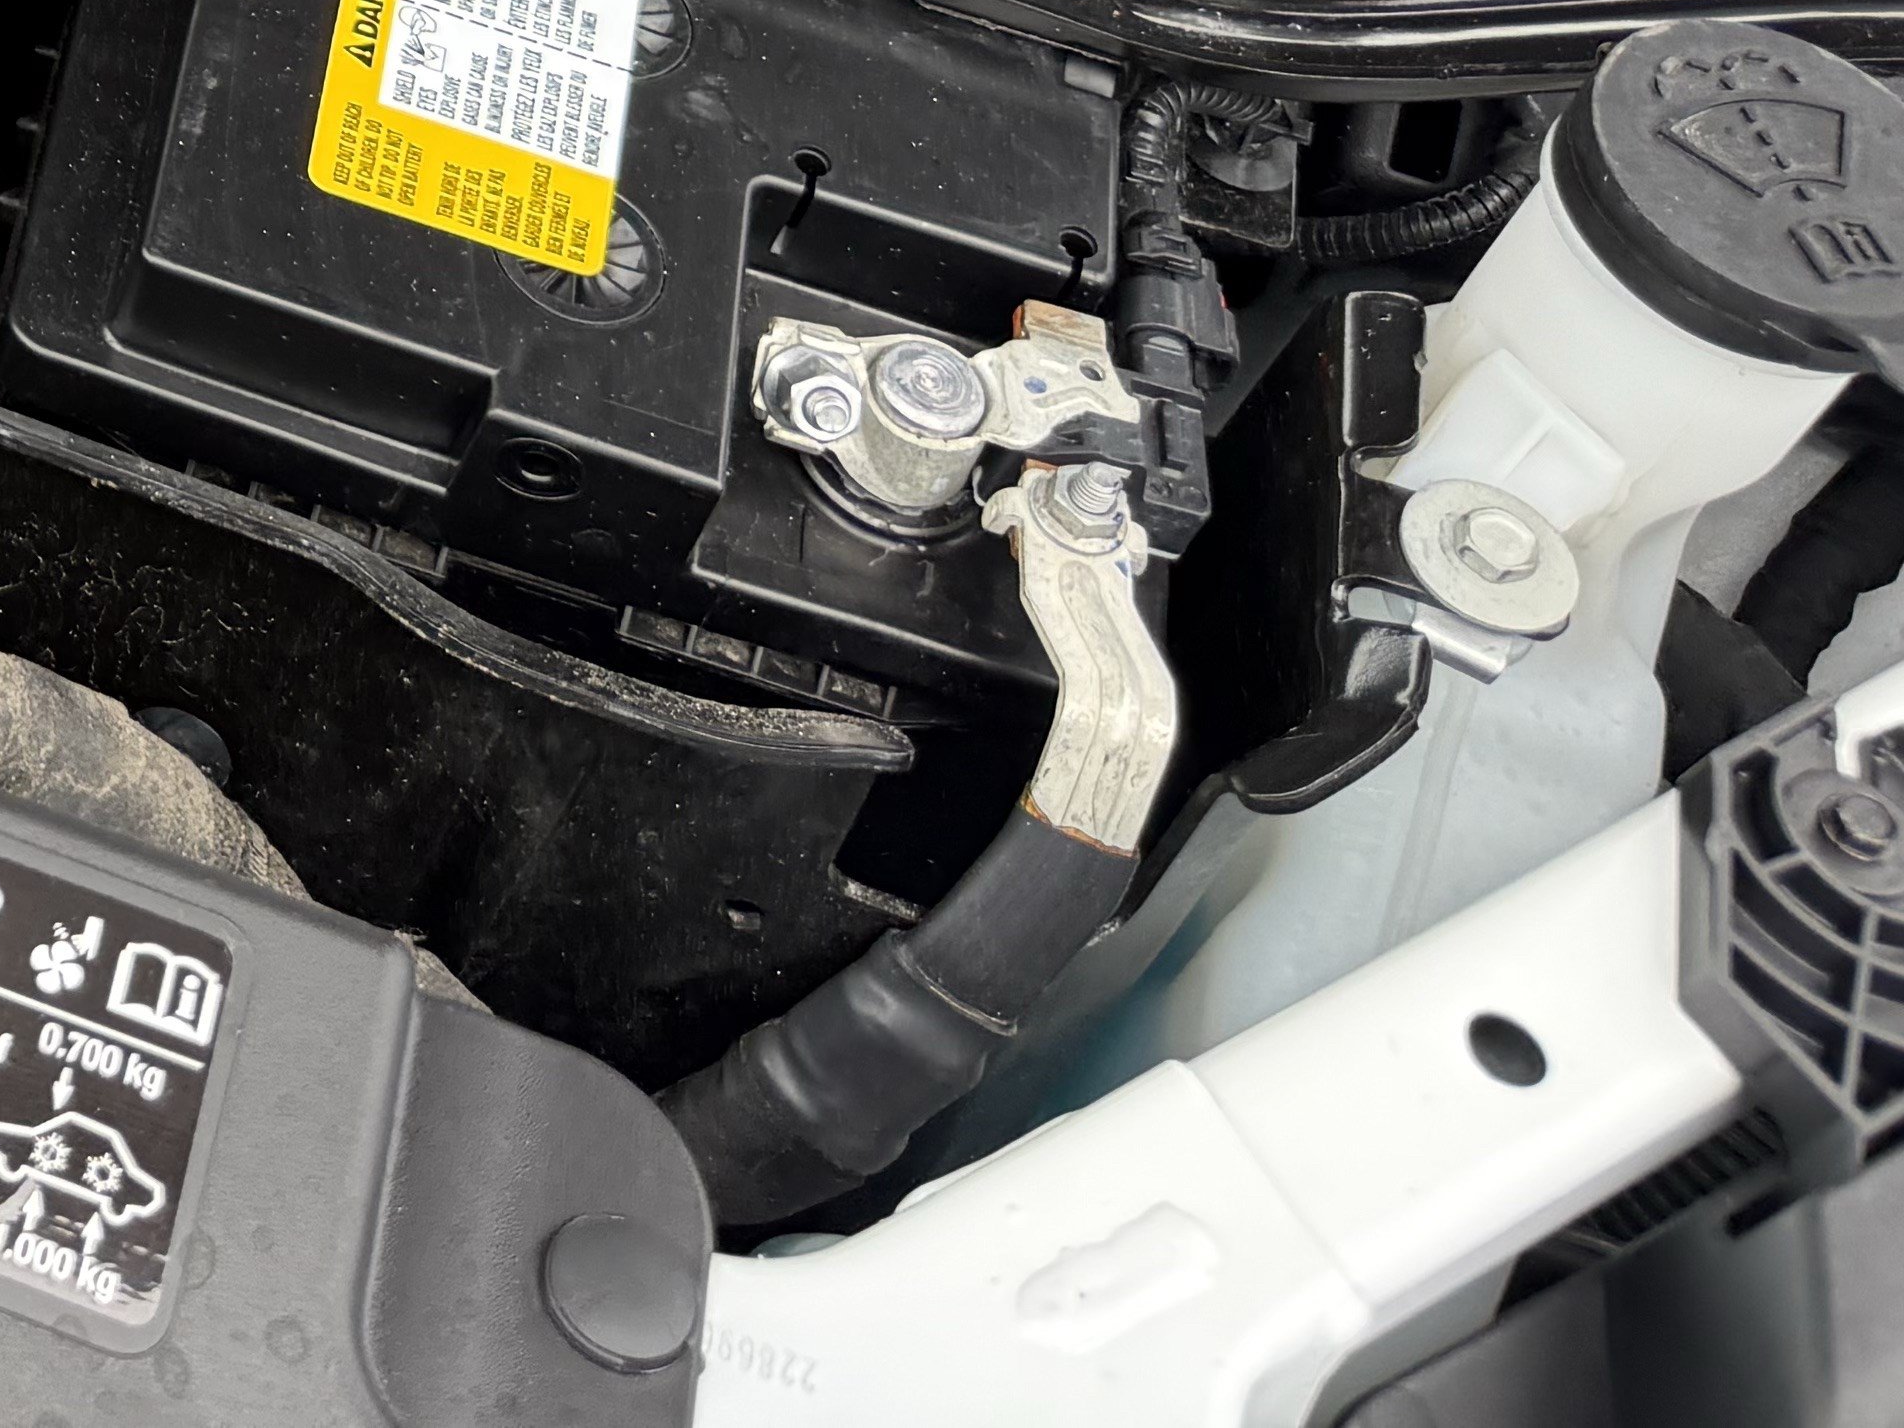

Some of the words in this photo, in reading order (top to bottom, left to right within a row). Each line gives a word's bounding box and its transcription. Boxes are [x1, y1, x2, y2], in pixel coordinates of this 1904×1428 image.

[522, 47, 542, 73] YEUX
[392, 69, 415, 104] SHIELD
[518, 73, 538, 94] LES
[416, 86, 437, 112] EYES
[38, 1022, 122, 1076] 0.700
[123, 1053, 165, 1100] kg
[75, 1255, 120, 1304] kg
